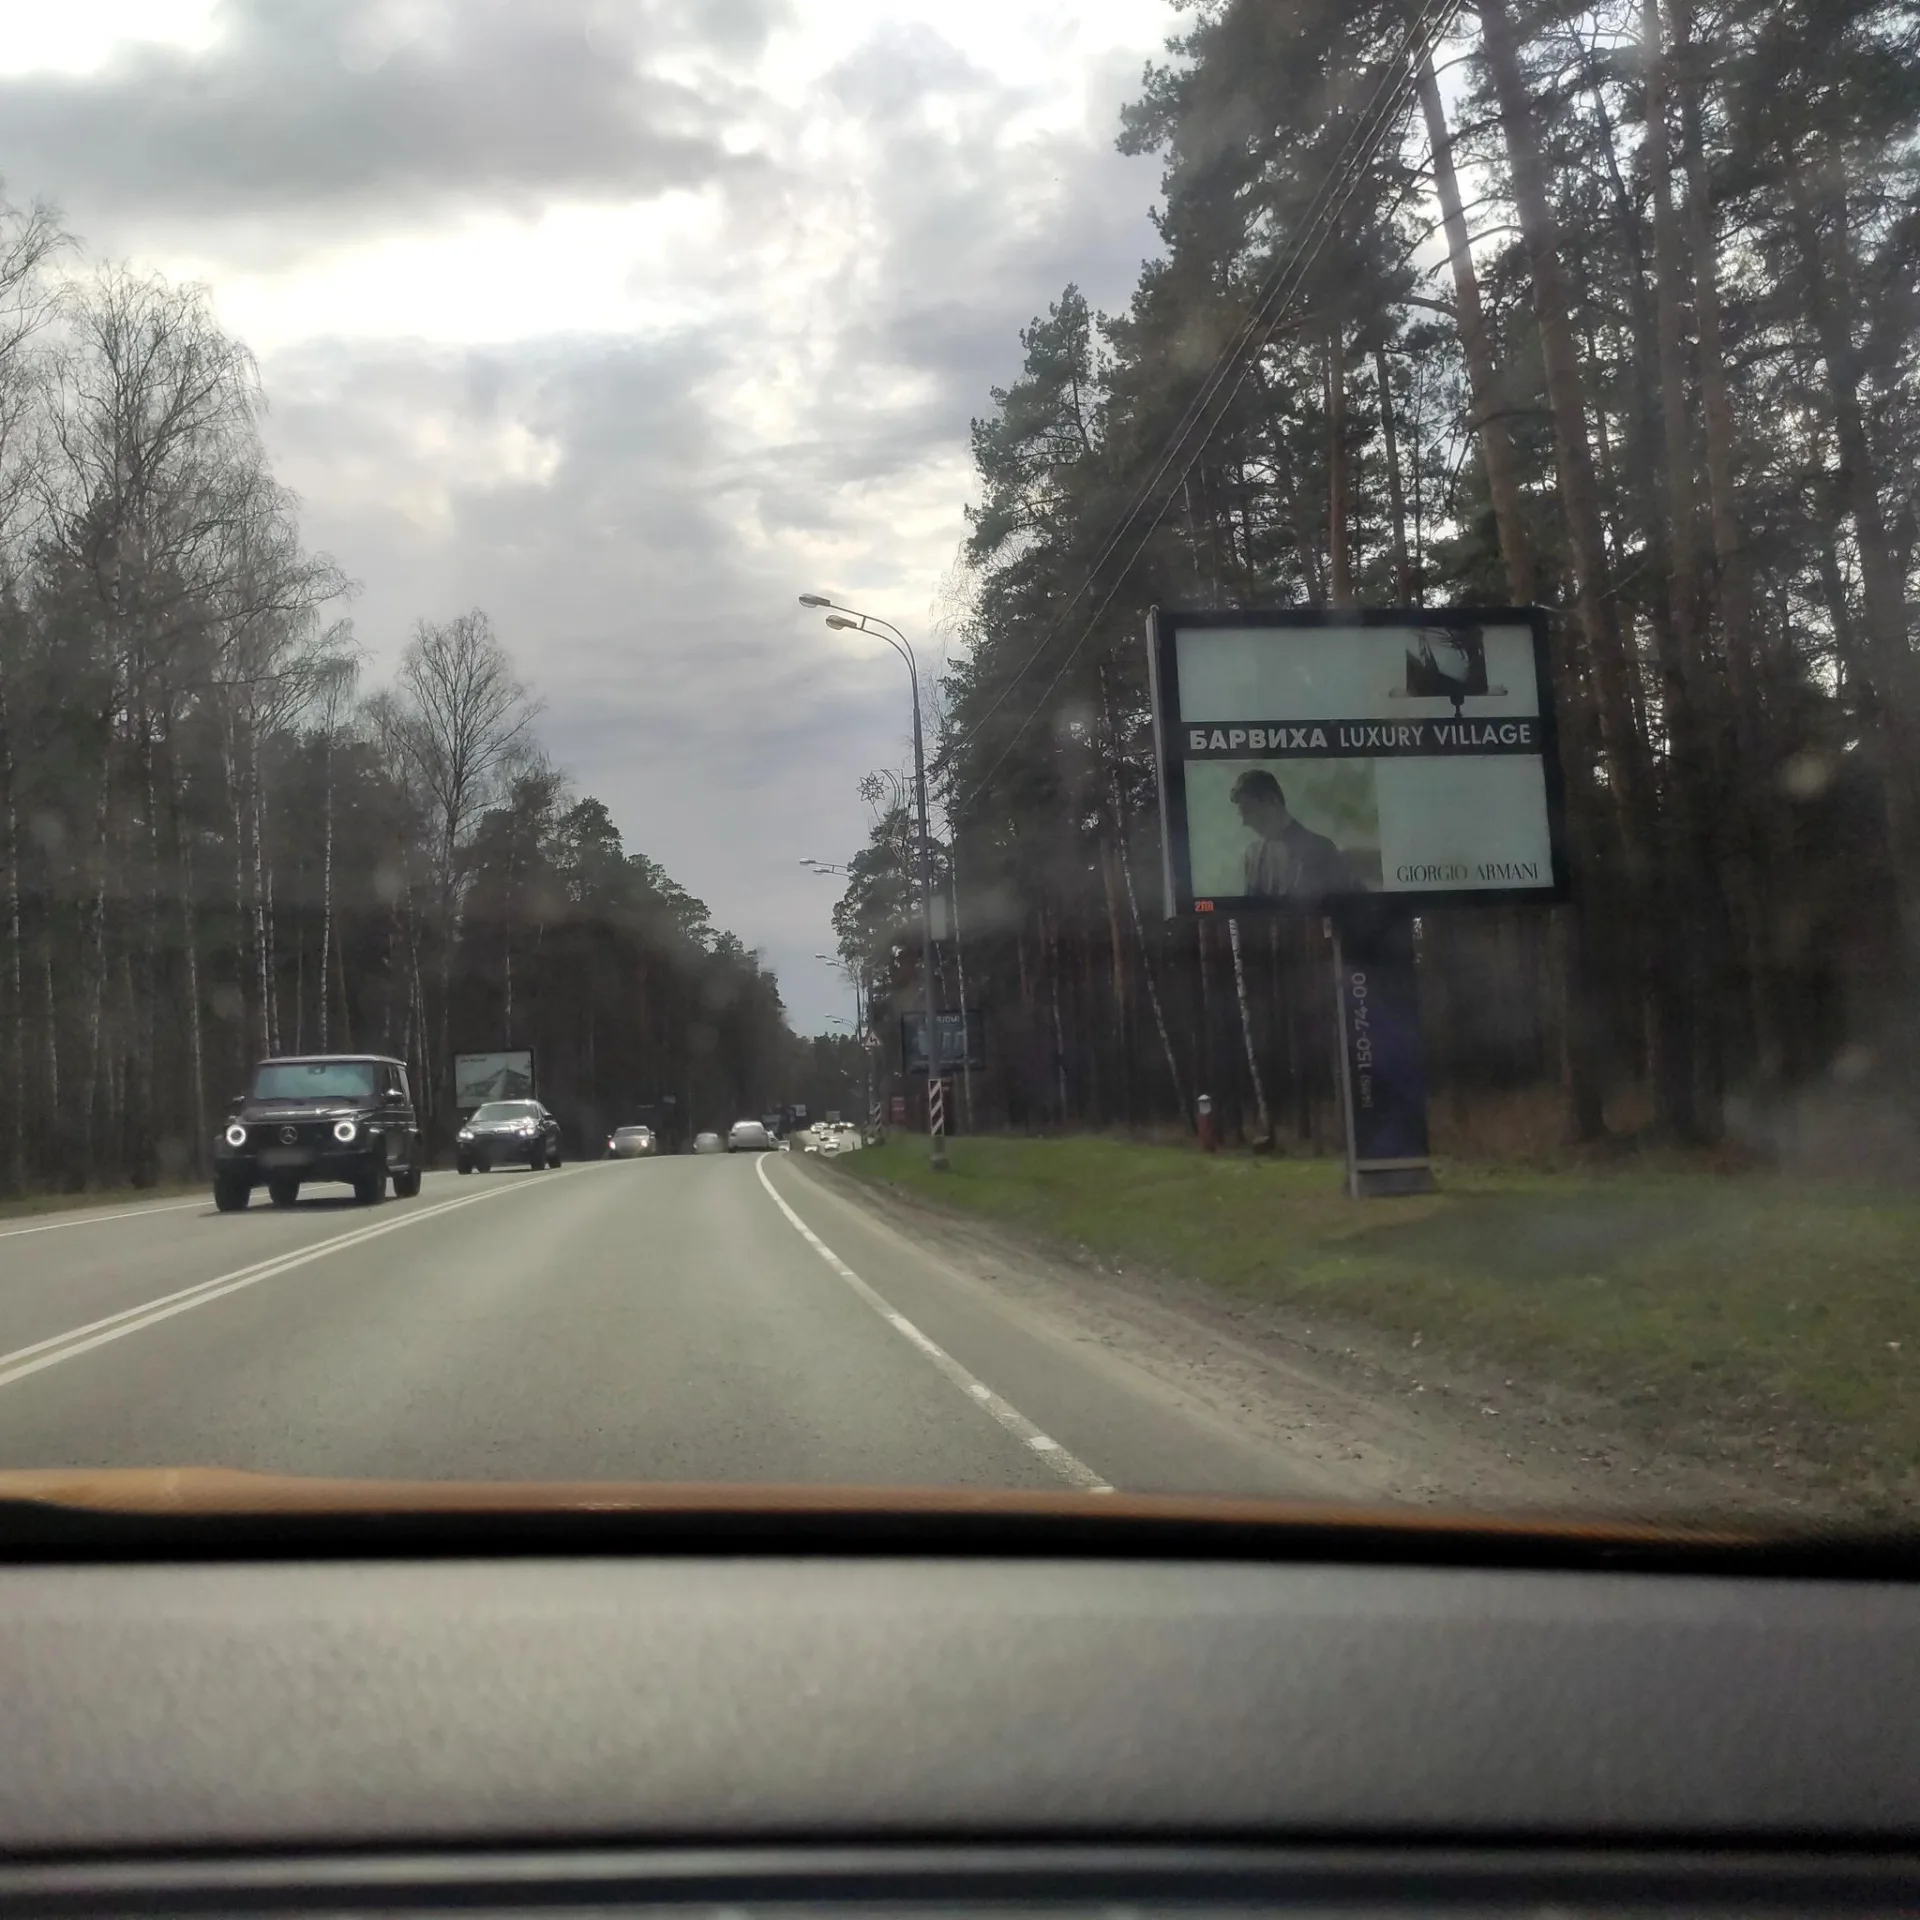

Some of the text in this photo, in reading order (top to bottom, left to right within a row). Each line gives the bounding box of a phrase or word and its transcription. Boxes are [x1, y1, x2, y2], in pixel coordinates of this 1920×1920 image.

[1189, 723, 1532, 750] БАРВИХА LUXURY VILLAGE
[1396, 861, 1539, 884] GIORGIO ARMANI
[1351, 972, 1372, 1069] 150-74-00
